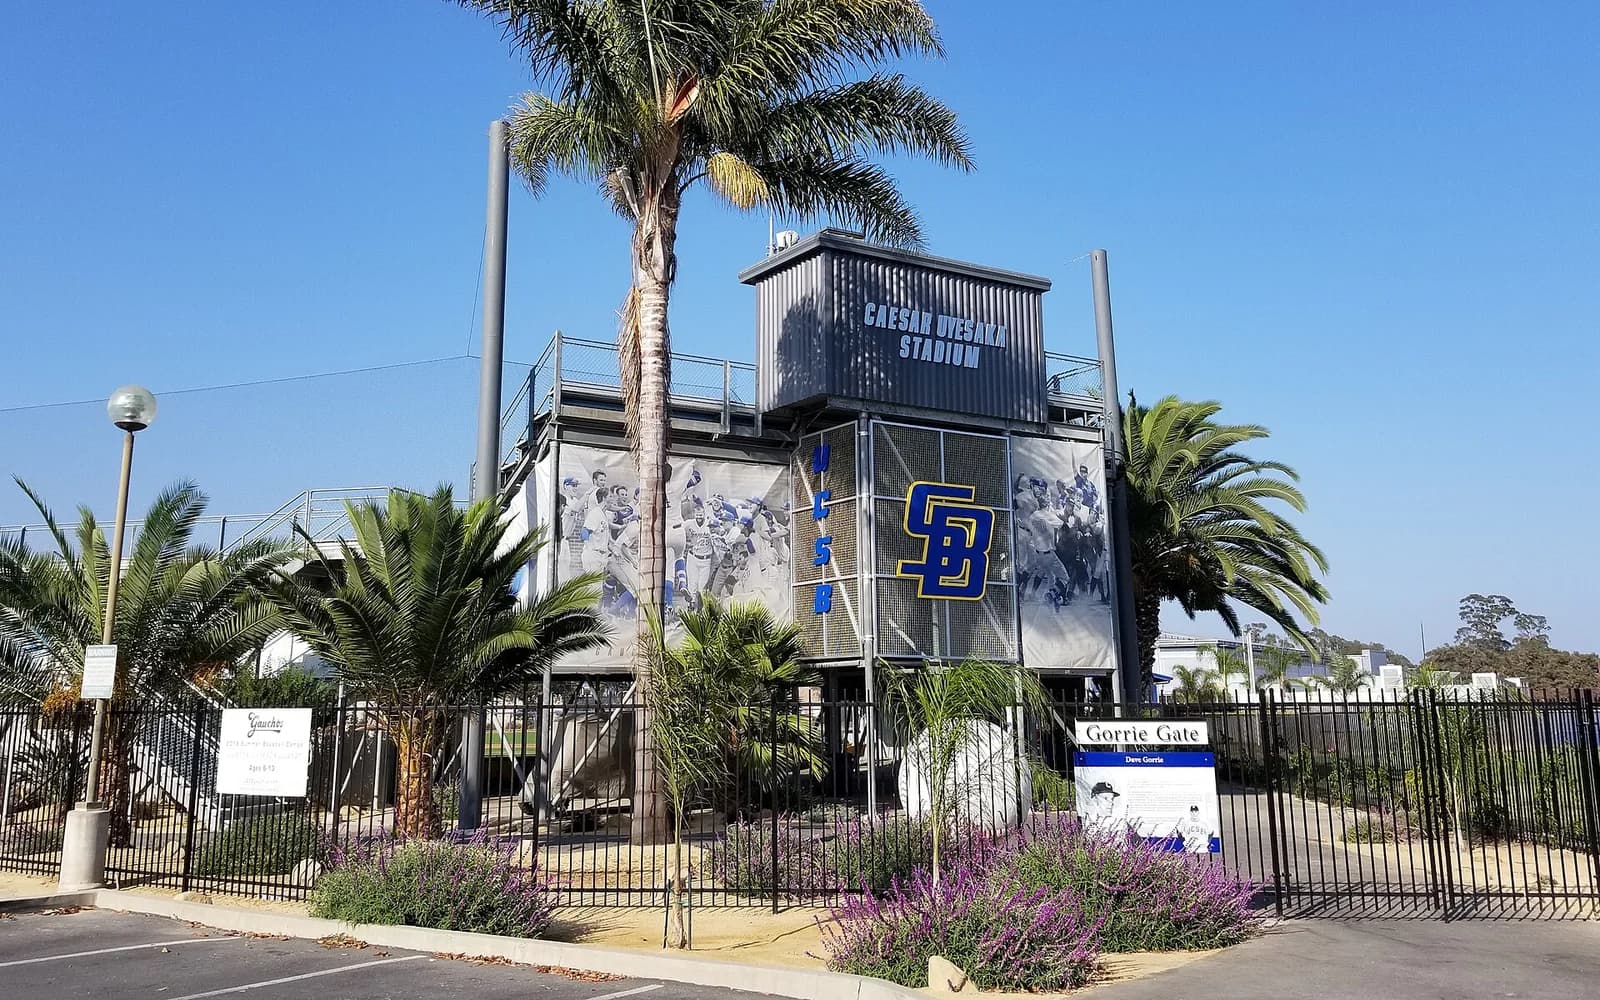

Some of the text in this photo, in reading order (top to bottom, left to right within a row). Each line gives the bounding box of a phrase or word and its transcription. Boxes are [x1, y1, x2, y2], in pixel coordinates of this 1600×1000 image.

[864, 302, 1008, 348] CAESAR UYESAKA
[899, 334, 980, 369] STADIUM
[812, 443, 832, 614] UCSB
[247, 712, 284, 738] Gauchos
[1086, 724, 1200, 742] Gorrie Gate
